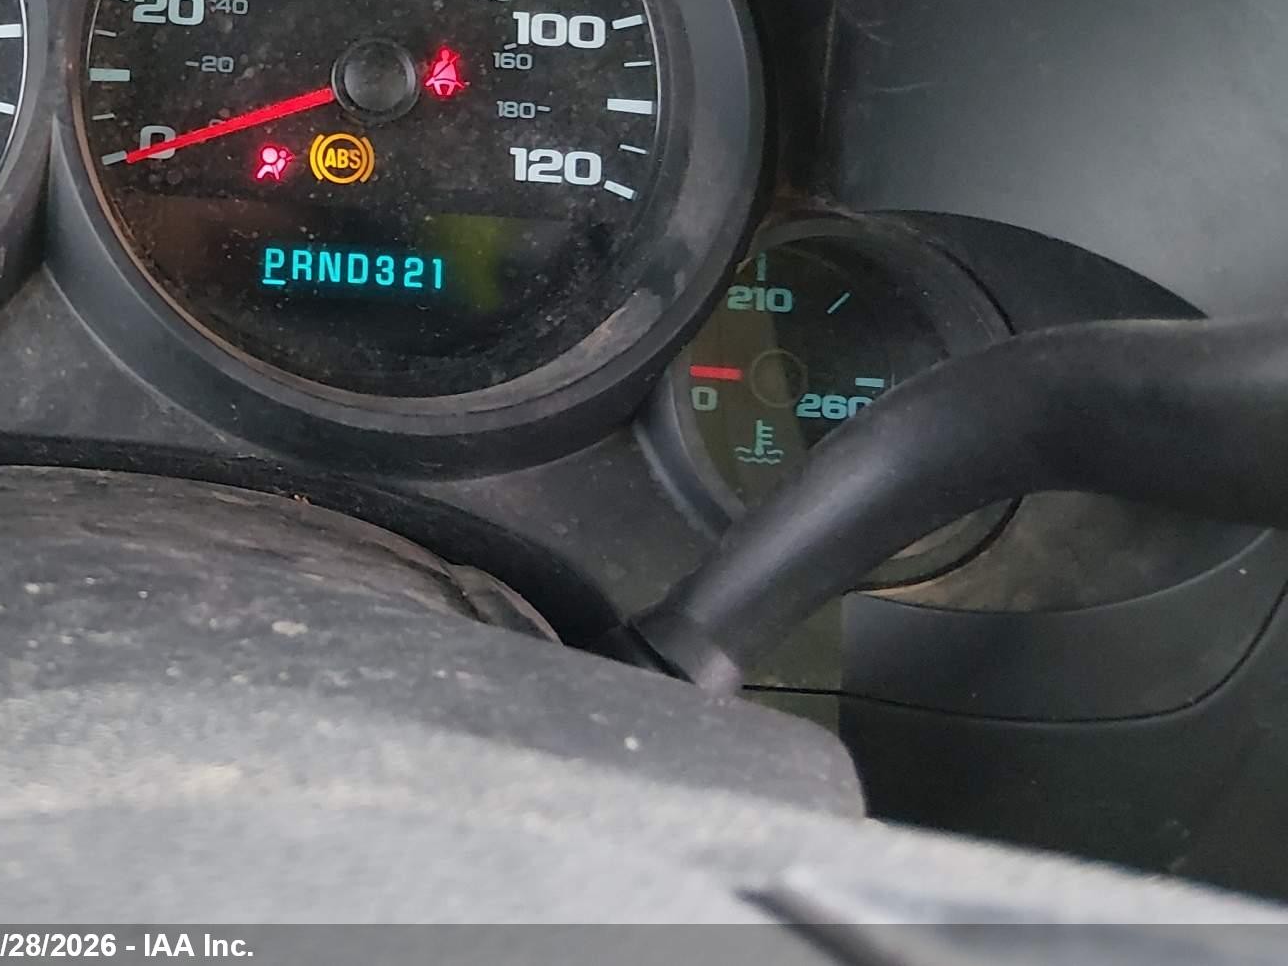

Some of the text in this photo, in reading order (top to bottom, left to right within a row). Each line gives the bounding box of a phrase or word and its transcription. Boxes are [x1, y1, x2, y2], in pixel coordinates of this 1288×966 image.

[513, 12, 606, 49] 100
[201, 55, 234, 73] 20
[493, 51, 533, 71] 160
[496, 100, 535, 119] 180
[324, 143, 362, 169] ABS
[510, 147, 602, 185] 120
[263, 248, 445, 289] PRND321
[727, 286, 793, 313] 210
[691, 386, 718, 411] 0
